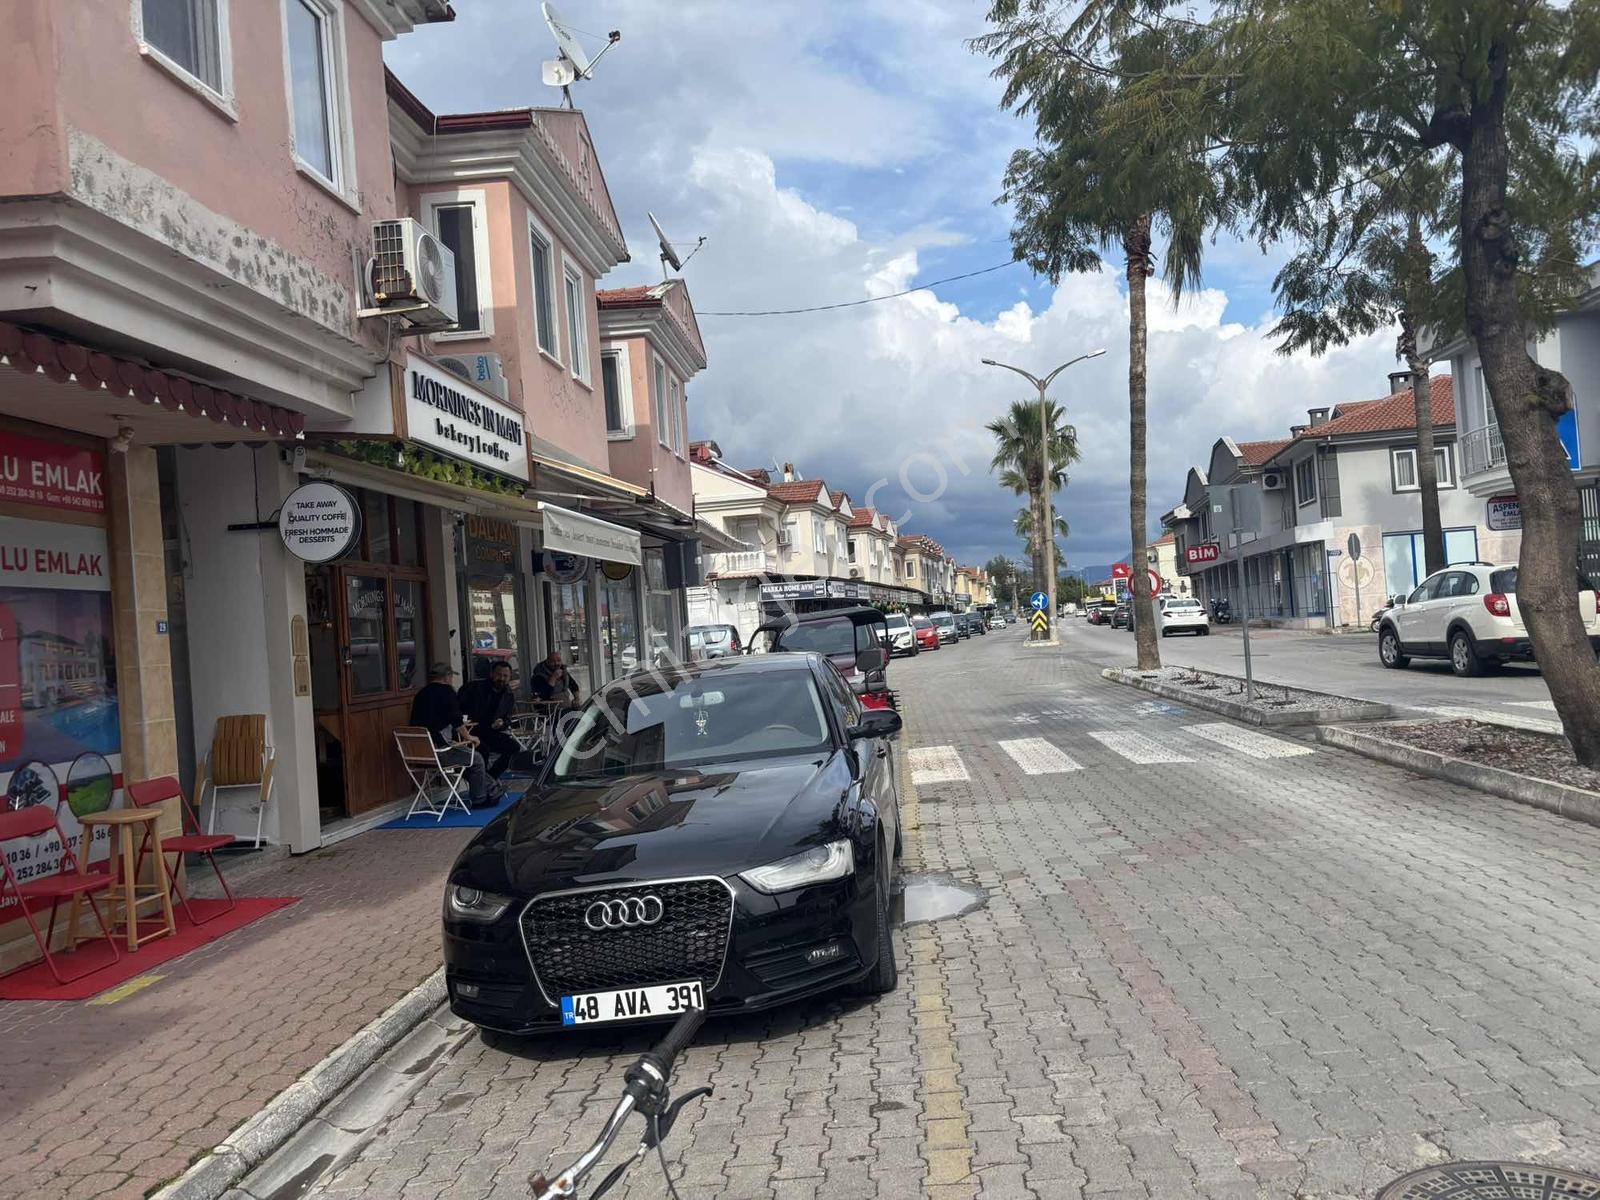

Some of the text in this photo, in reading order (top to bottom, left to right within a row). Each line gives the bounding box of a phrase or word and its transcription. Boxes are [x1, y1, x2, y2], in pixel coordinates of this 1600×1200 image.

[475, 355, 487, 381] beko
[411, 371, 482, 426] MORNINGS
[481, 405, 495, 432] IN
[435, 418, 475, 453] bakery
[482, 440, 511, 462] coffee
[32, 460, 104, 496] EMLAK
[296, 500, 337, 510] TAKE AWAY
[284, 526, 349, 537] FRESH HOMMADE
[288, 514, 320, 523] QUALITY
[298, 535, 335, 544] DESSERTS
[35, 549, 103, 577] EMLAK
[16, 866, 34, 881] 252
[574, 995, 600, 1021] 48
[614, 989, 652, 1018] AVA
[665, 983, 703, 1012] 391
